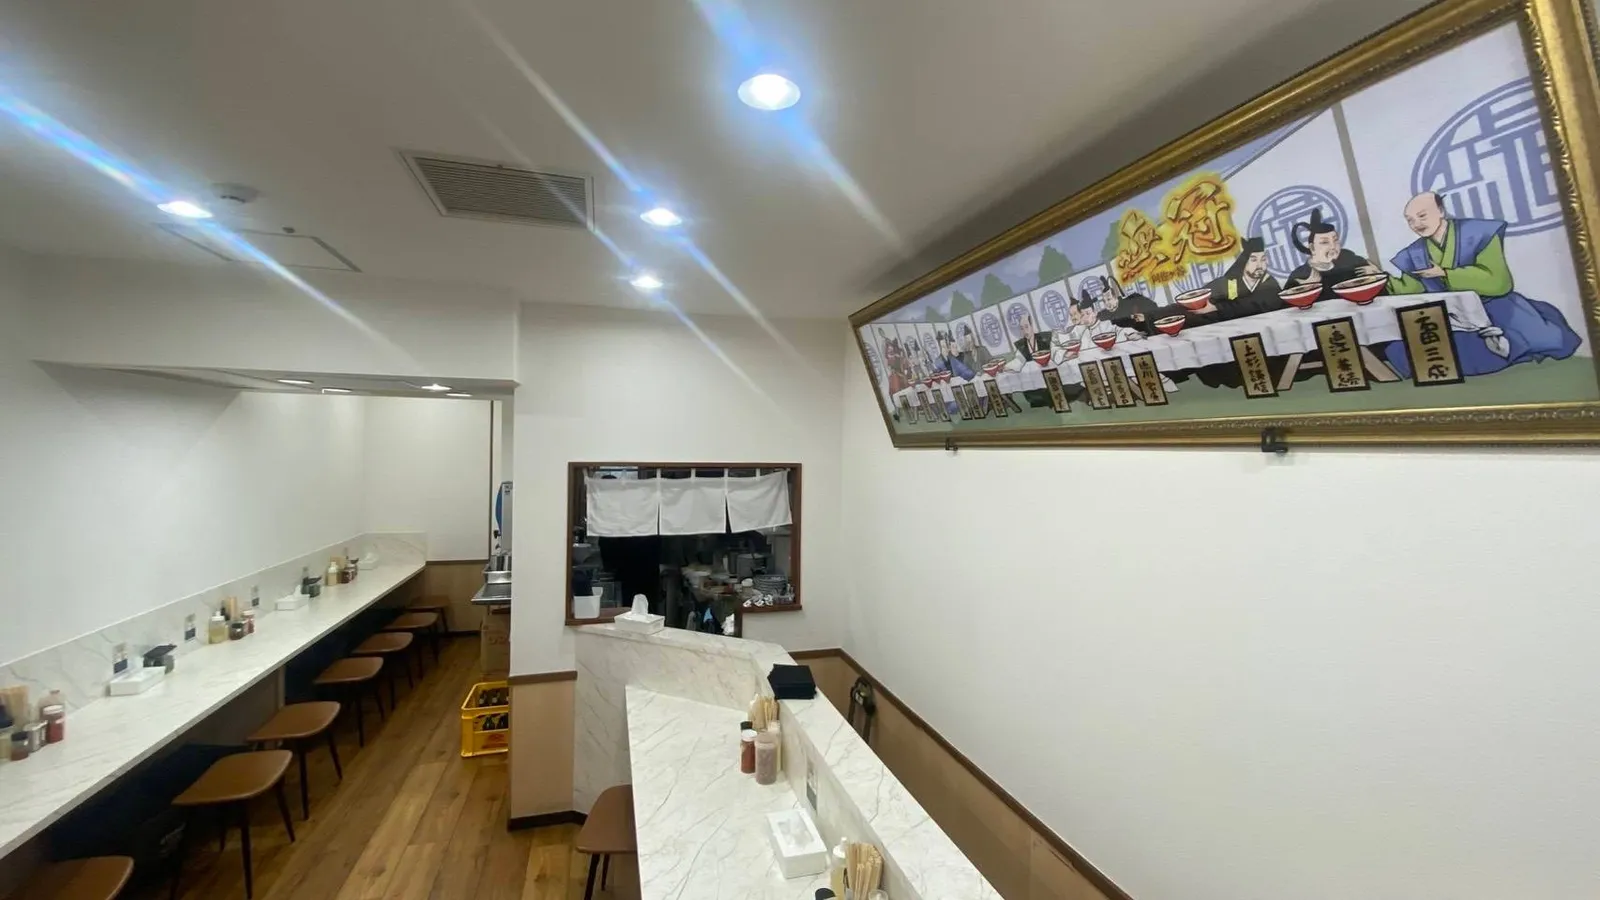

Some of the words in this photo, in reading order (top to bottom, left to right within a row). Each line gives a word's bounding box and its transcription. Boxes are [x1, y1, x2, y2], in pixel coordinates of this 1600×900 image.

[1244, 344, 1269, 393] 上杉謙信
[1414, 316, 1450, 380] 石田三成
